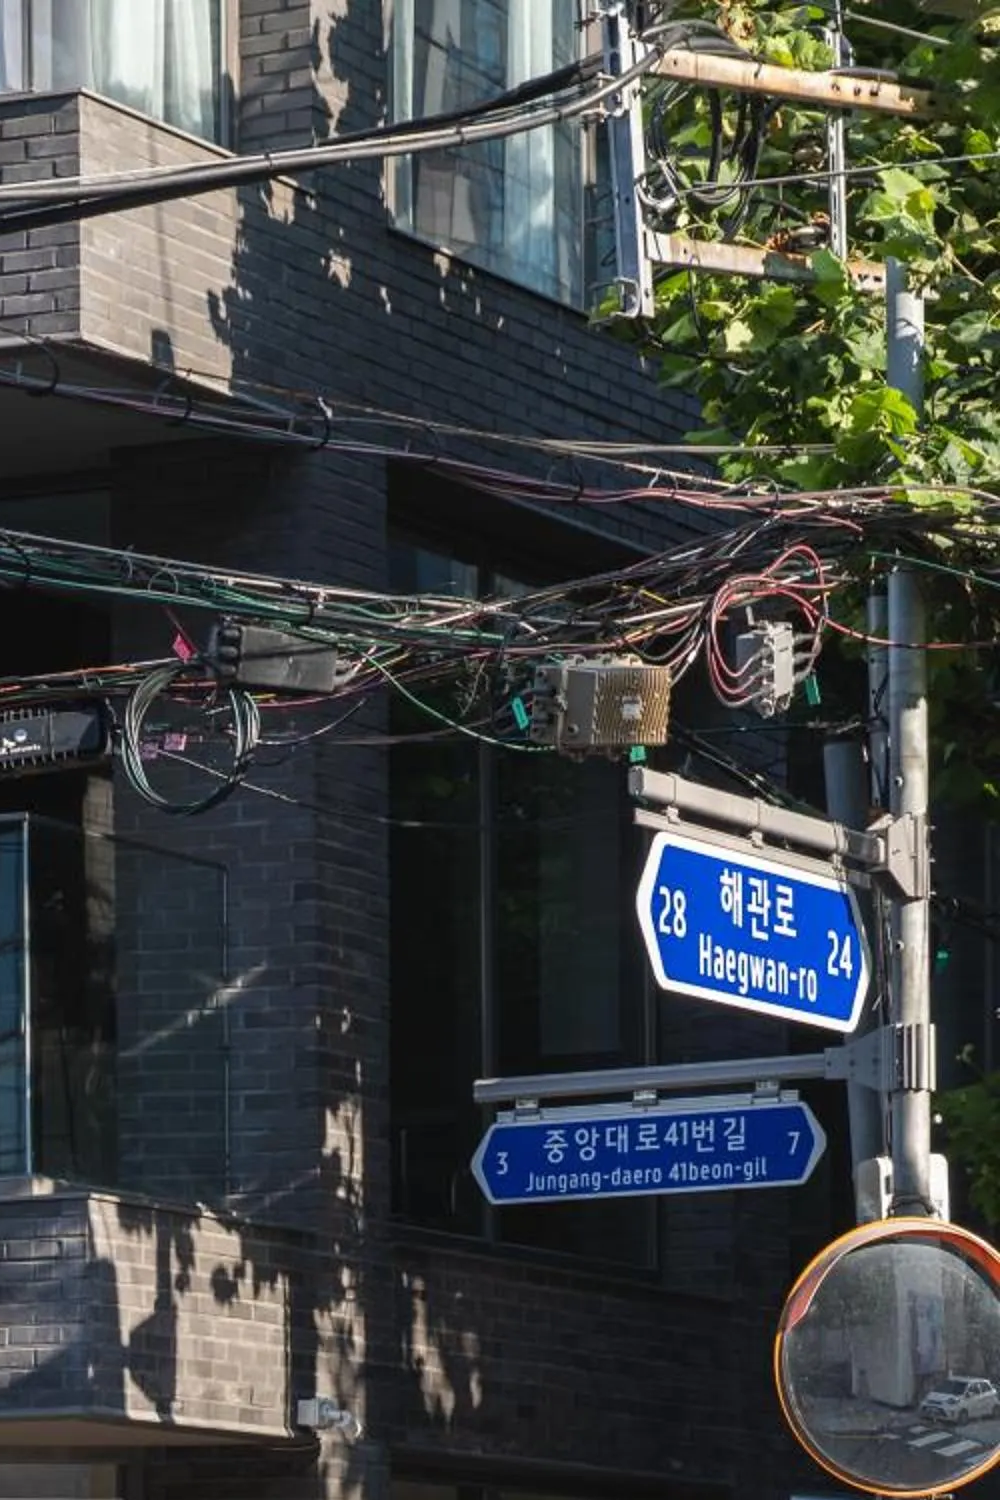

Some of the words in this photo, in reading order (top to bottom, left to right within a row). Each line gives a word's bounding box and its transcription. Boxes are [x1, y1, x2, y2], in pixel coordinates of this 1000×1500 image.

[658, 884, 688, 939] 28
[718, 867, 798, 941] 해관로
[698, 931, 818, 1003] Haegwan-ro
[826, 929, 854, 980] 24
[495, 1150, 509, 1176] 3
[542, 1115, 747, 1164] 중앙대로41번길
[787, 1130, 801, 1156] 7
[524, 1164, 664, 1193] Jungang-daero
[668, 1157, 768, 1183] 41beon-gil
